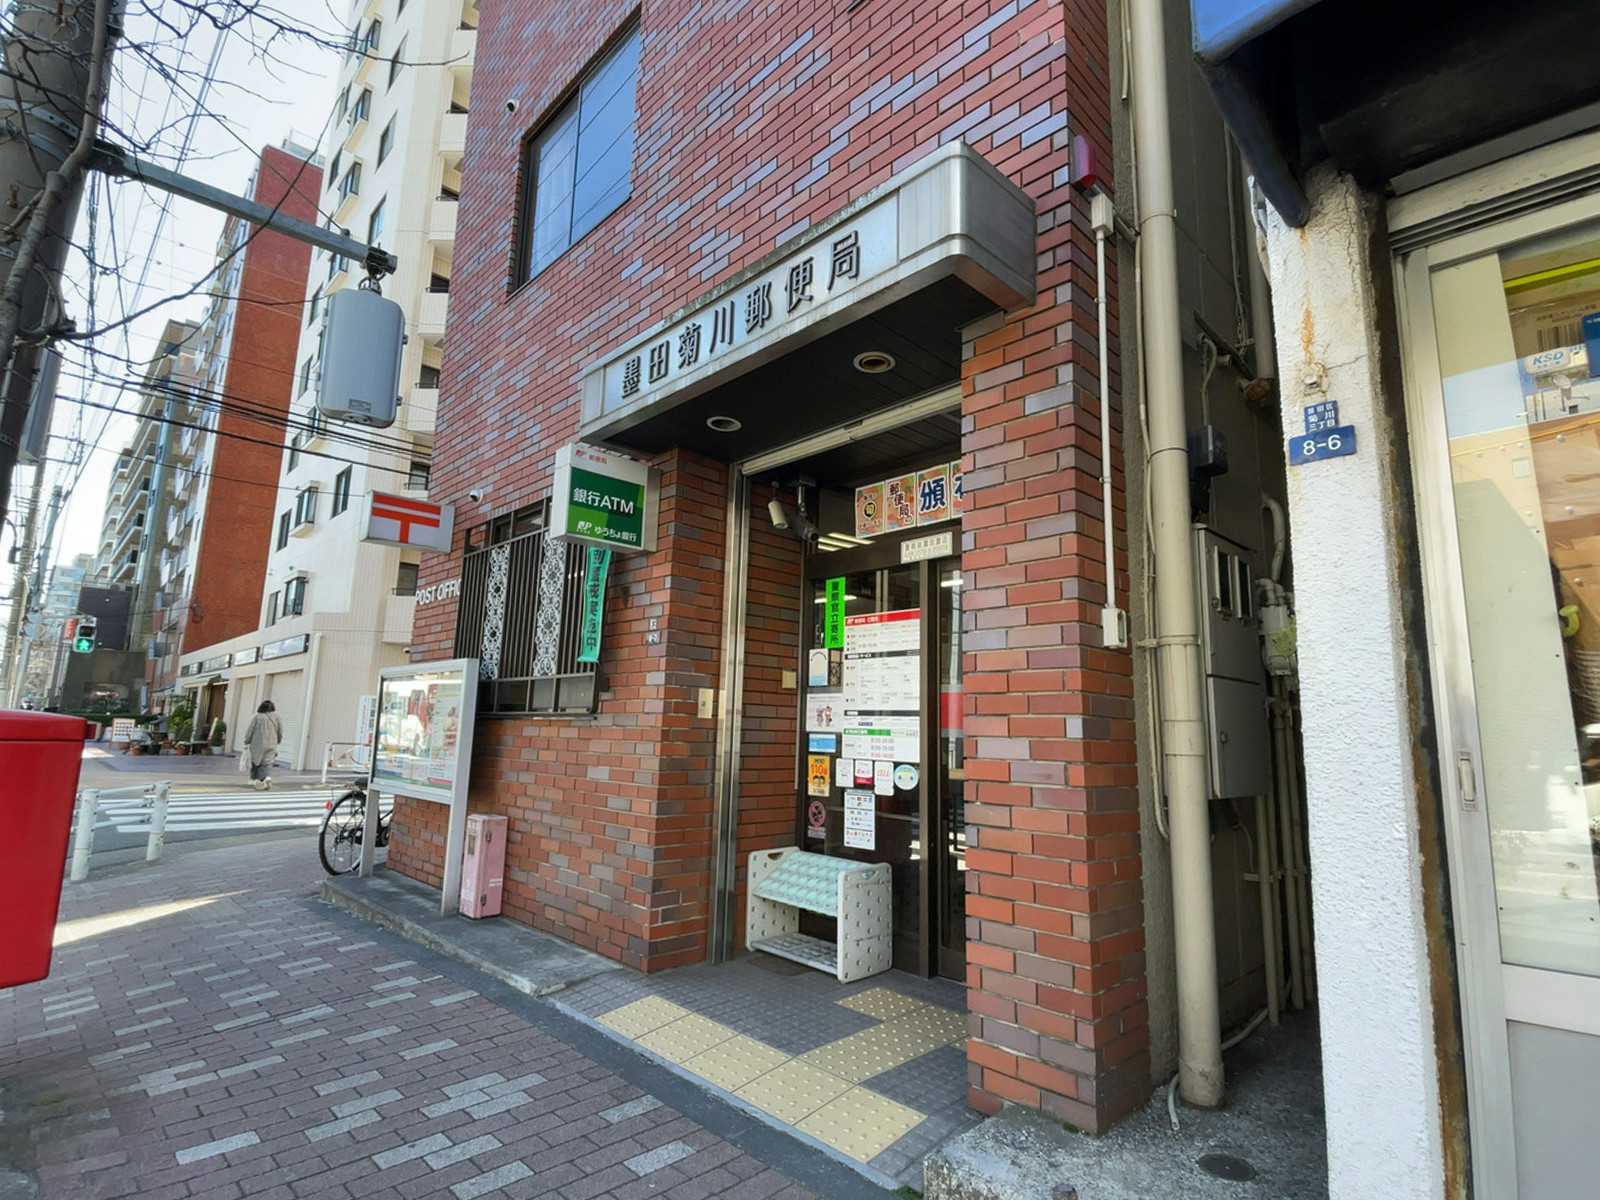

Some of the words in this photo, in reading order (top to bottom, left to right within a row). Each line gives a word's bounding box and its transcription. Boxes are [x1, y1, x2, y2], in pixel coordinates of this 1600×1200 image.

[620, 229, 861, 399] 墨田菊川郵便局
[1533, 351, 1564, 366] KSD
[1303, 434, 1342, 456] 8-6
[573, 487, 635, 515] 銀行ATM
[594, 525, 638, 543] ゆうちょ銀行
